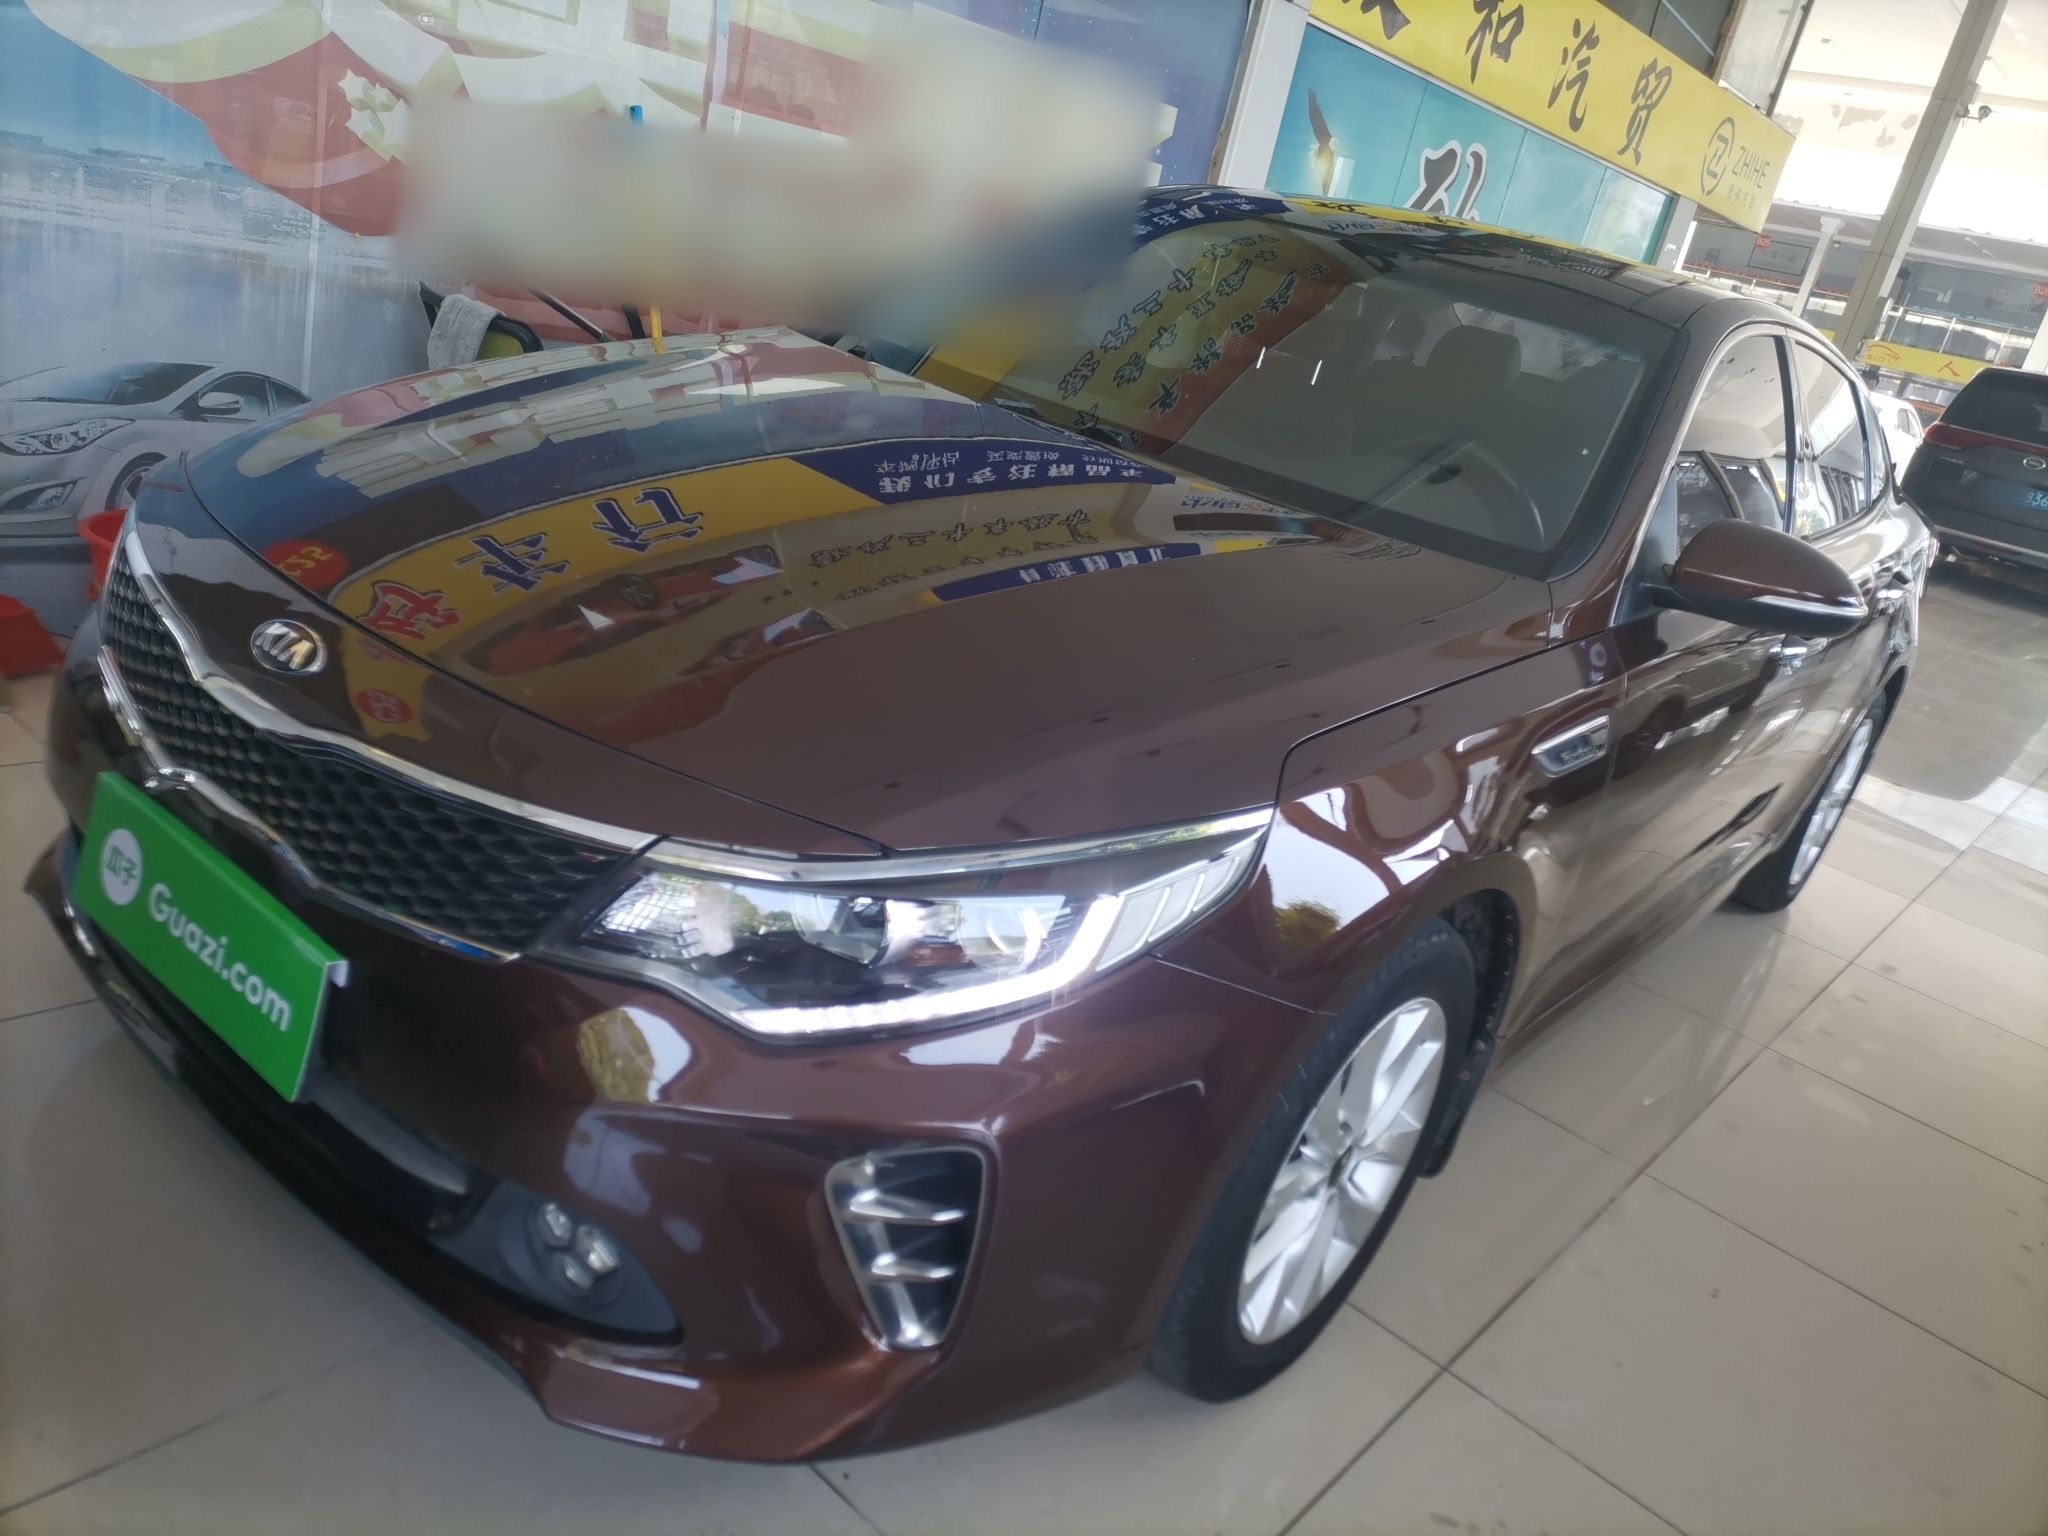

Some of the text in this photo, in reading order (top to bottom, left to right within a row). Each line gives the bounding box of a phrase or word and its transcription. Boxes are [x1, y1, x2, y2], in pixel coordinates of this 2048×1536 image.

[1732, 146, 1771, 189] ZHIHE
[254, 622, 315, 671] KIA
[105, 844, 138, 887] 瓜子
[148, 883, 292, 1032] Guazi.com
